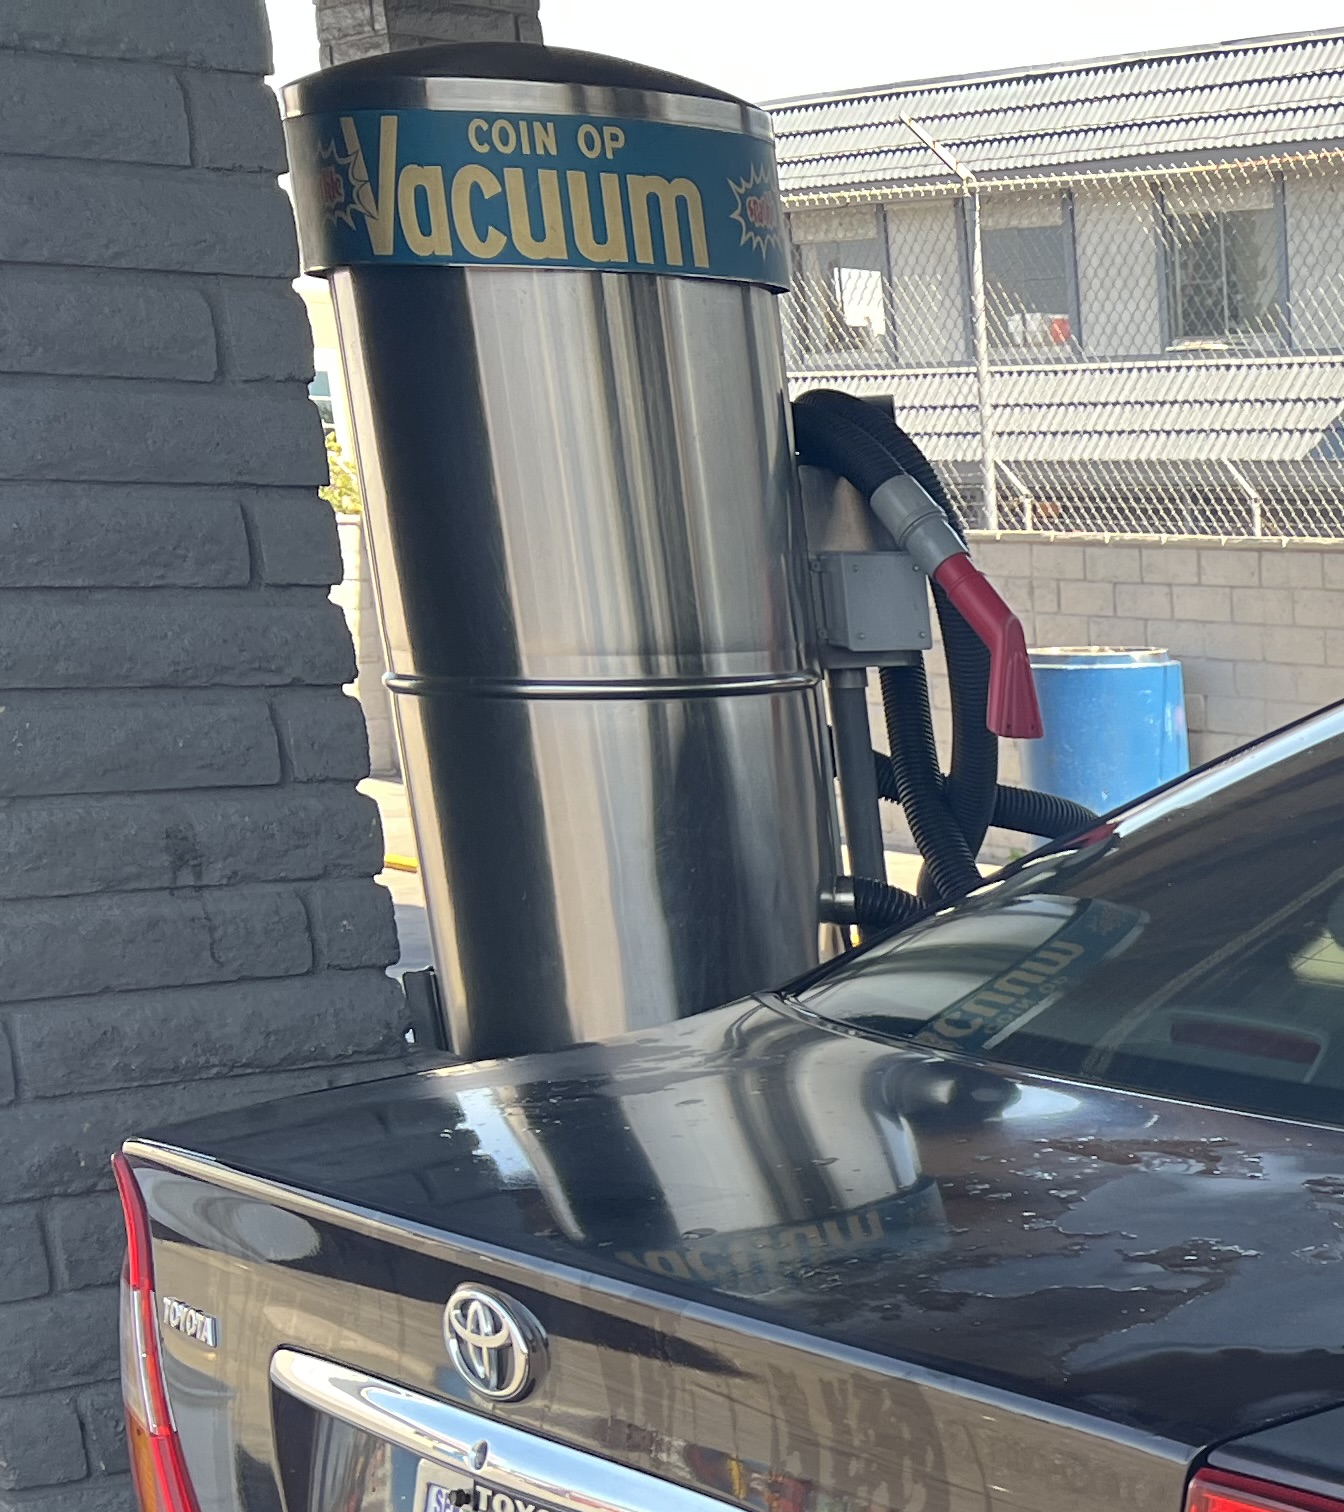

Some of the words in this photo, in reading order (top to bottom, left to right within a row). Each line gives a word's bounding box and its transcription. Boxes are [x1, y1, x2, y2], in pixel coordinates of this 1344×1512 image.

[468, 117, 558, 157] COIN
[577, 123, 626, 160] OP
[340, 115, 710, 269] Vacuum
[162, 1296, 217, 1349] TOYOTA
